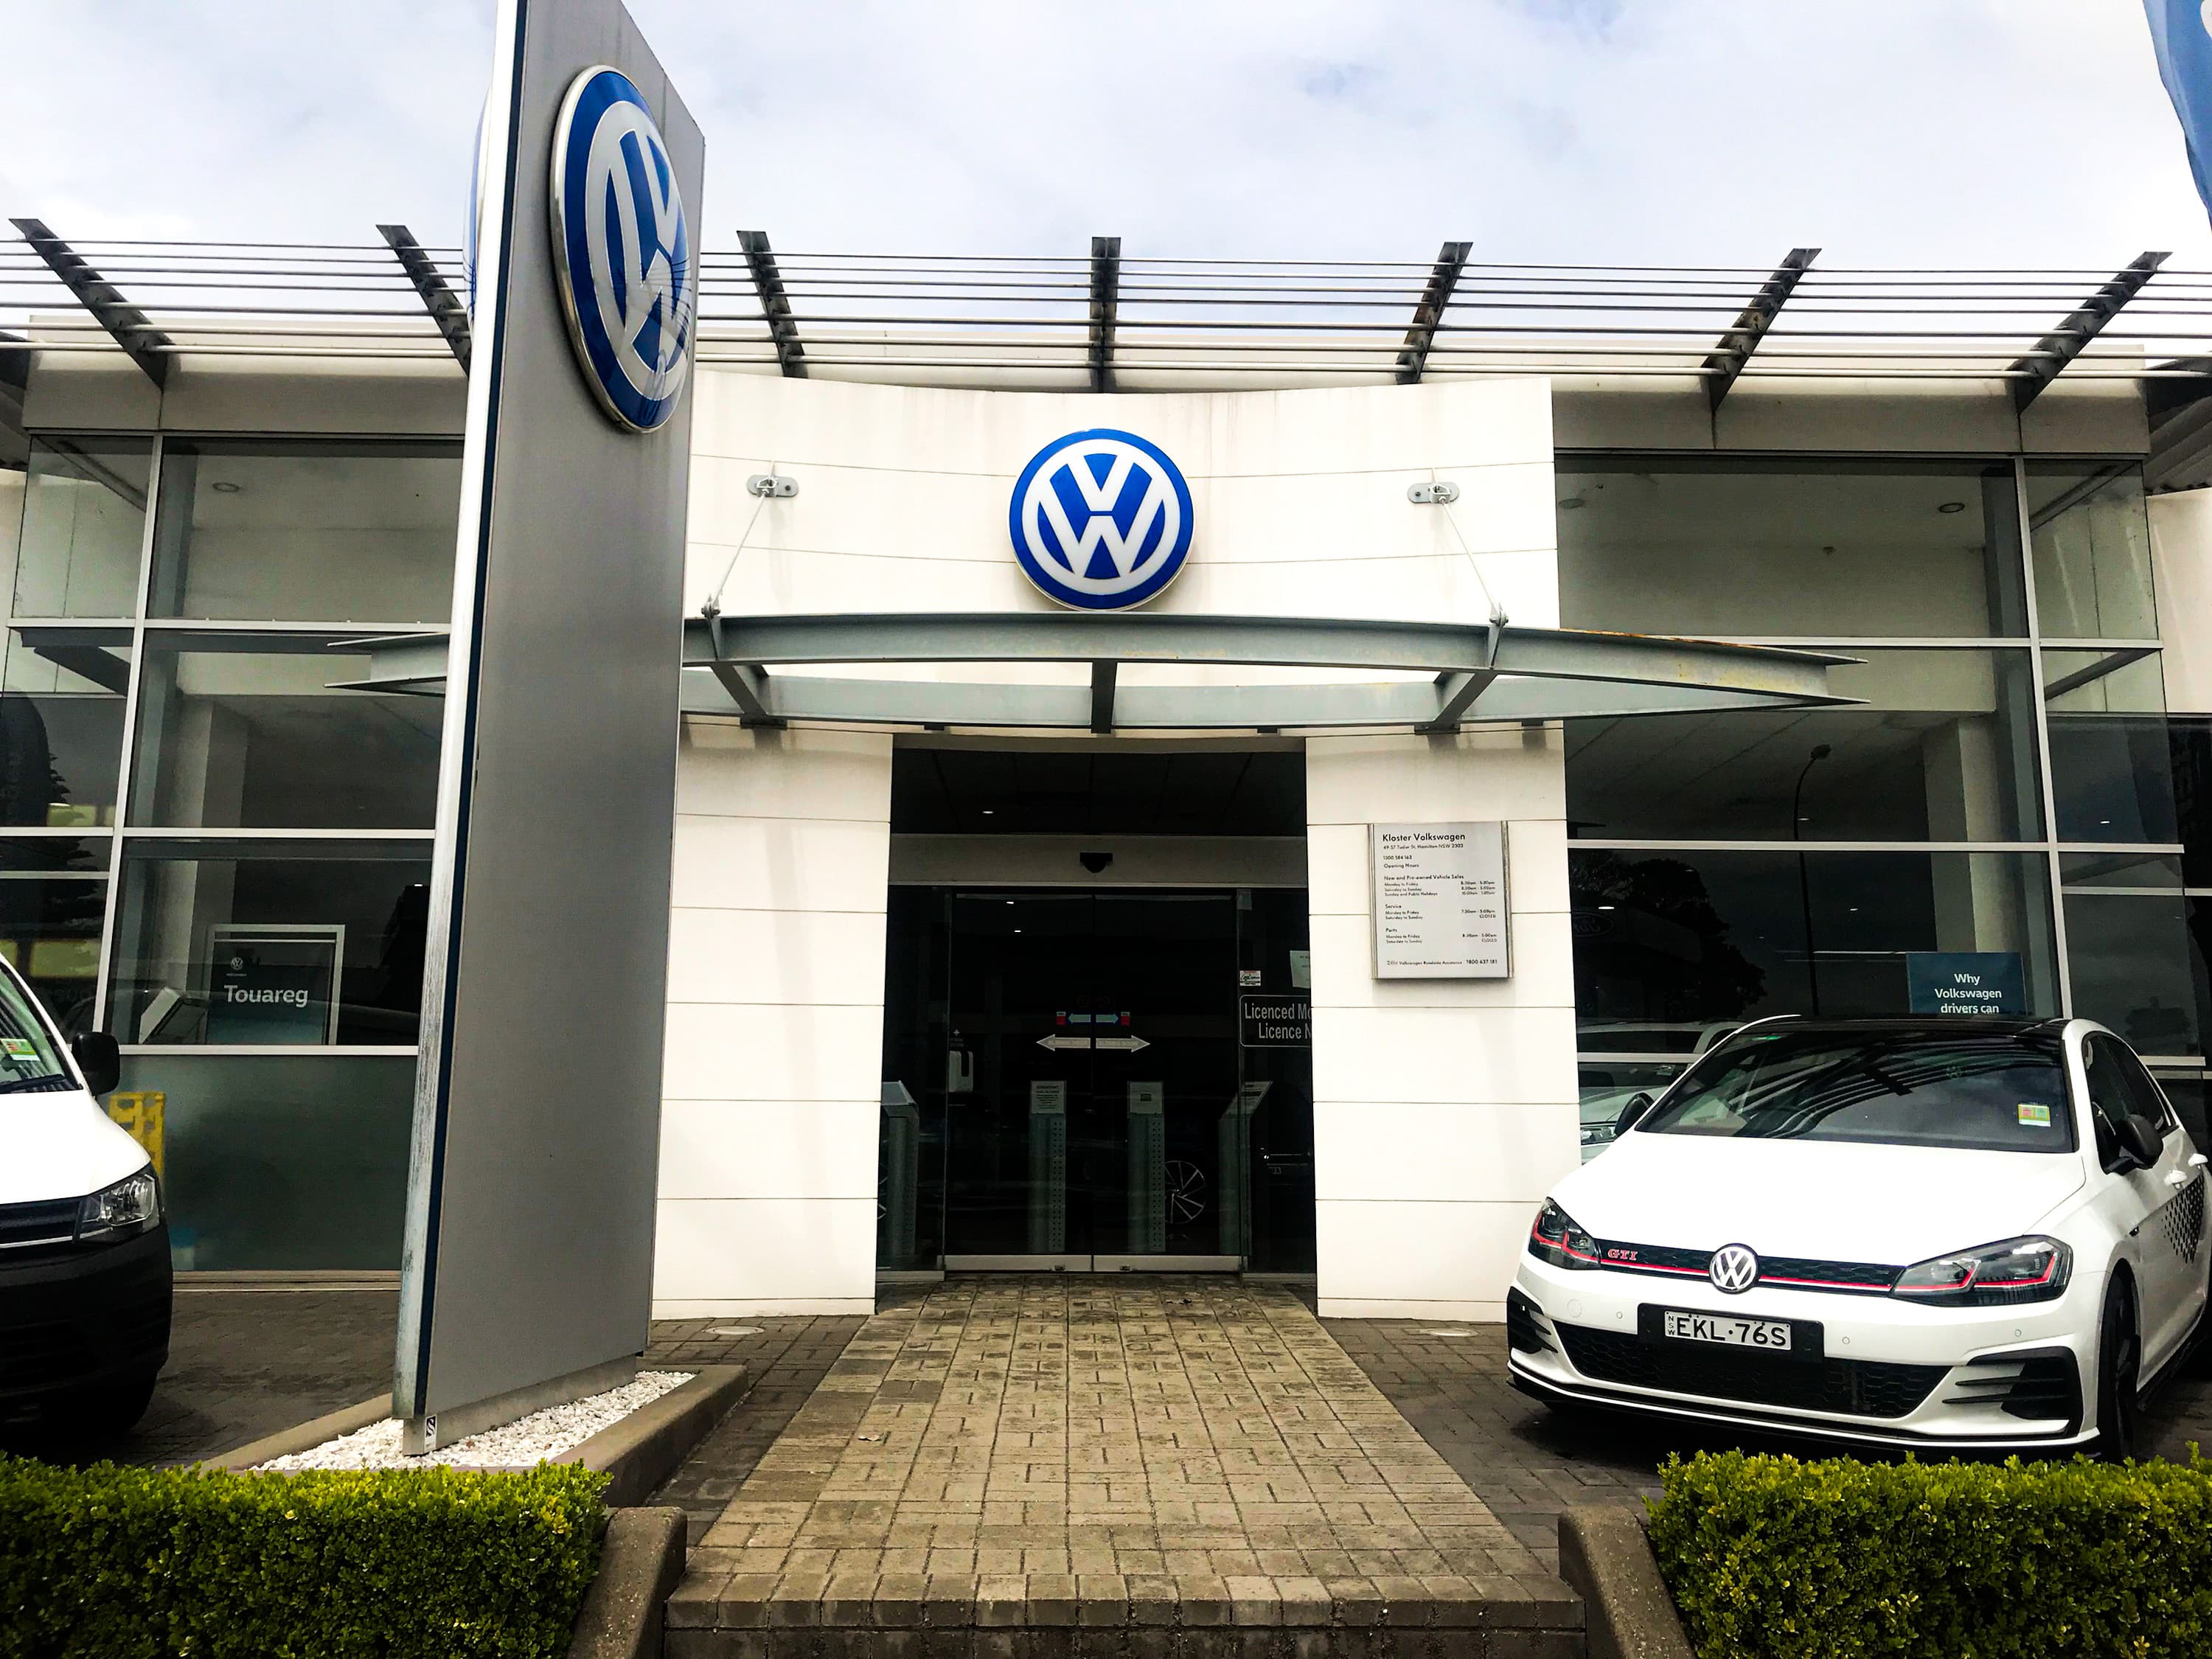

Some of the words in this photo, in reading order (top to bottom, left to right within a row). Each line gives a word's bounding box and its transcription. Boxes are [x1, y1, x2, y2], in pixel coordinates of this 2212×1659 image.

[1022, 439, 1180, 596] VW
[1382, 833, 1411, 841] Kloster
[1413, 832, 1465, 842] Volkswagen
[1954, 973, 1980, 986] Why
[224, 985, 308, 1008] Touareg
[1934, 987, 2002, 1001] Volkswagen
[1245, 1002, 1295, 1020] Licenced
[1940, 1003, 1978, 1014] drivers
[1980, 1004, 2000, 1014] can
[1259, 1022, 1301, 1039] Licence
[1607, 1248, 1638, 1262] GTI
[1710, 1245, 1758, 1291] VW
